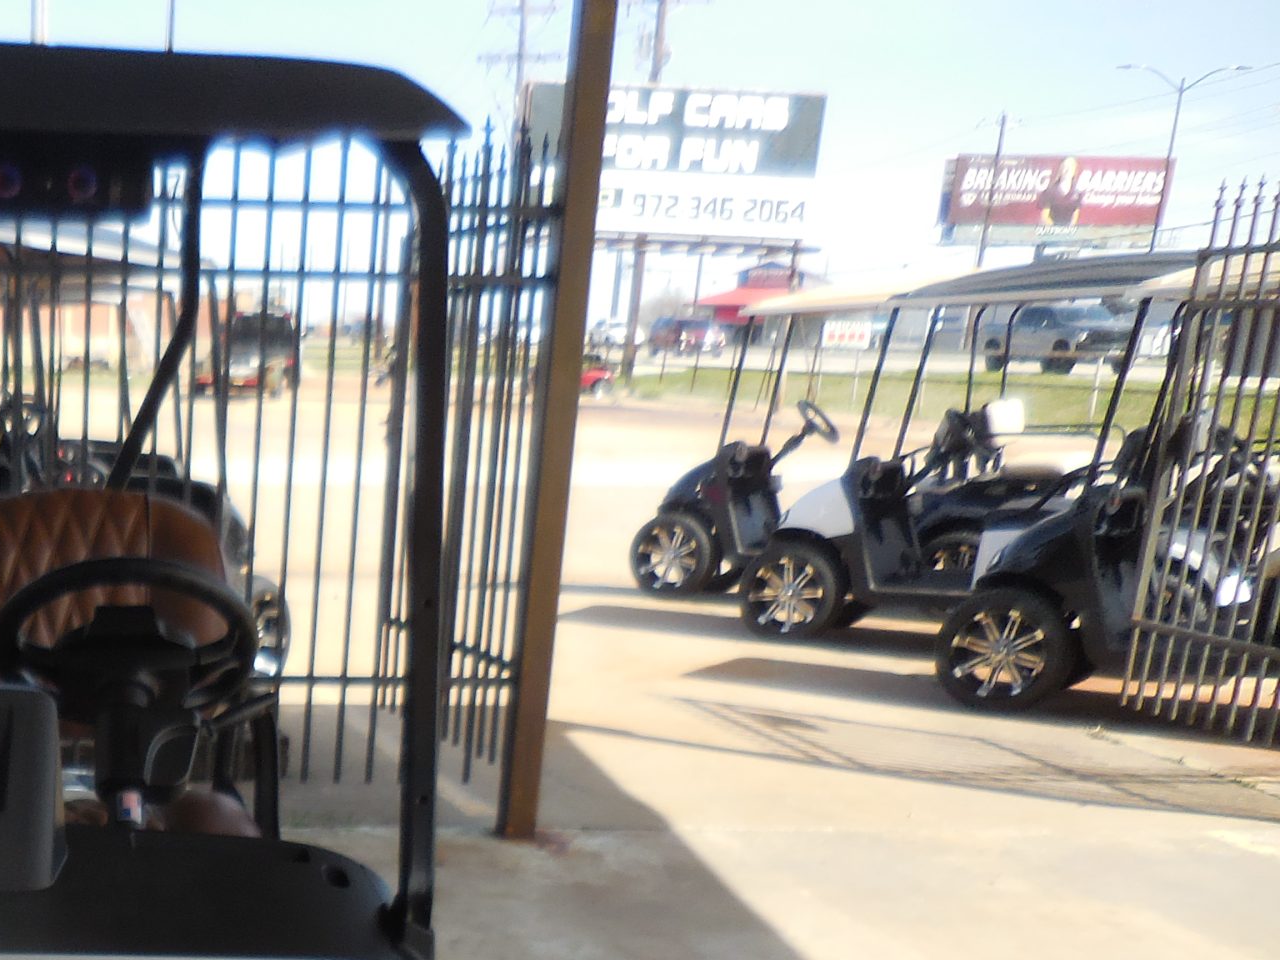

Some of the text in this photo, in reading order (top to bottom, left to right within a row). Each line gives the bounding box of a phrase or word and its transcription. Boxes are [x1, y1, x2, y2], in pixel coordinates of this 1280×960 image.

[683, 92, 790, 131] CARS
[678, 137, 760, 174] FUN
[1075, 169, 1166, 194] BARRIERS
[632, 193, 806, 224] 972 346 2064
